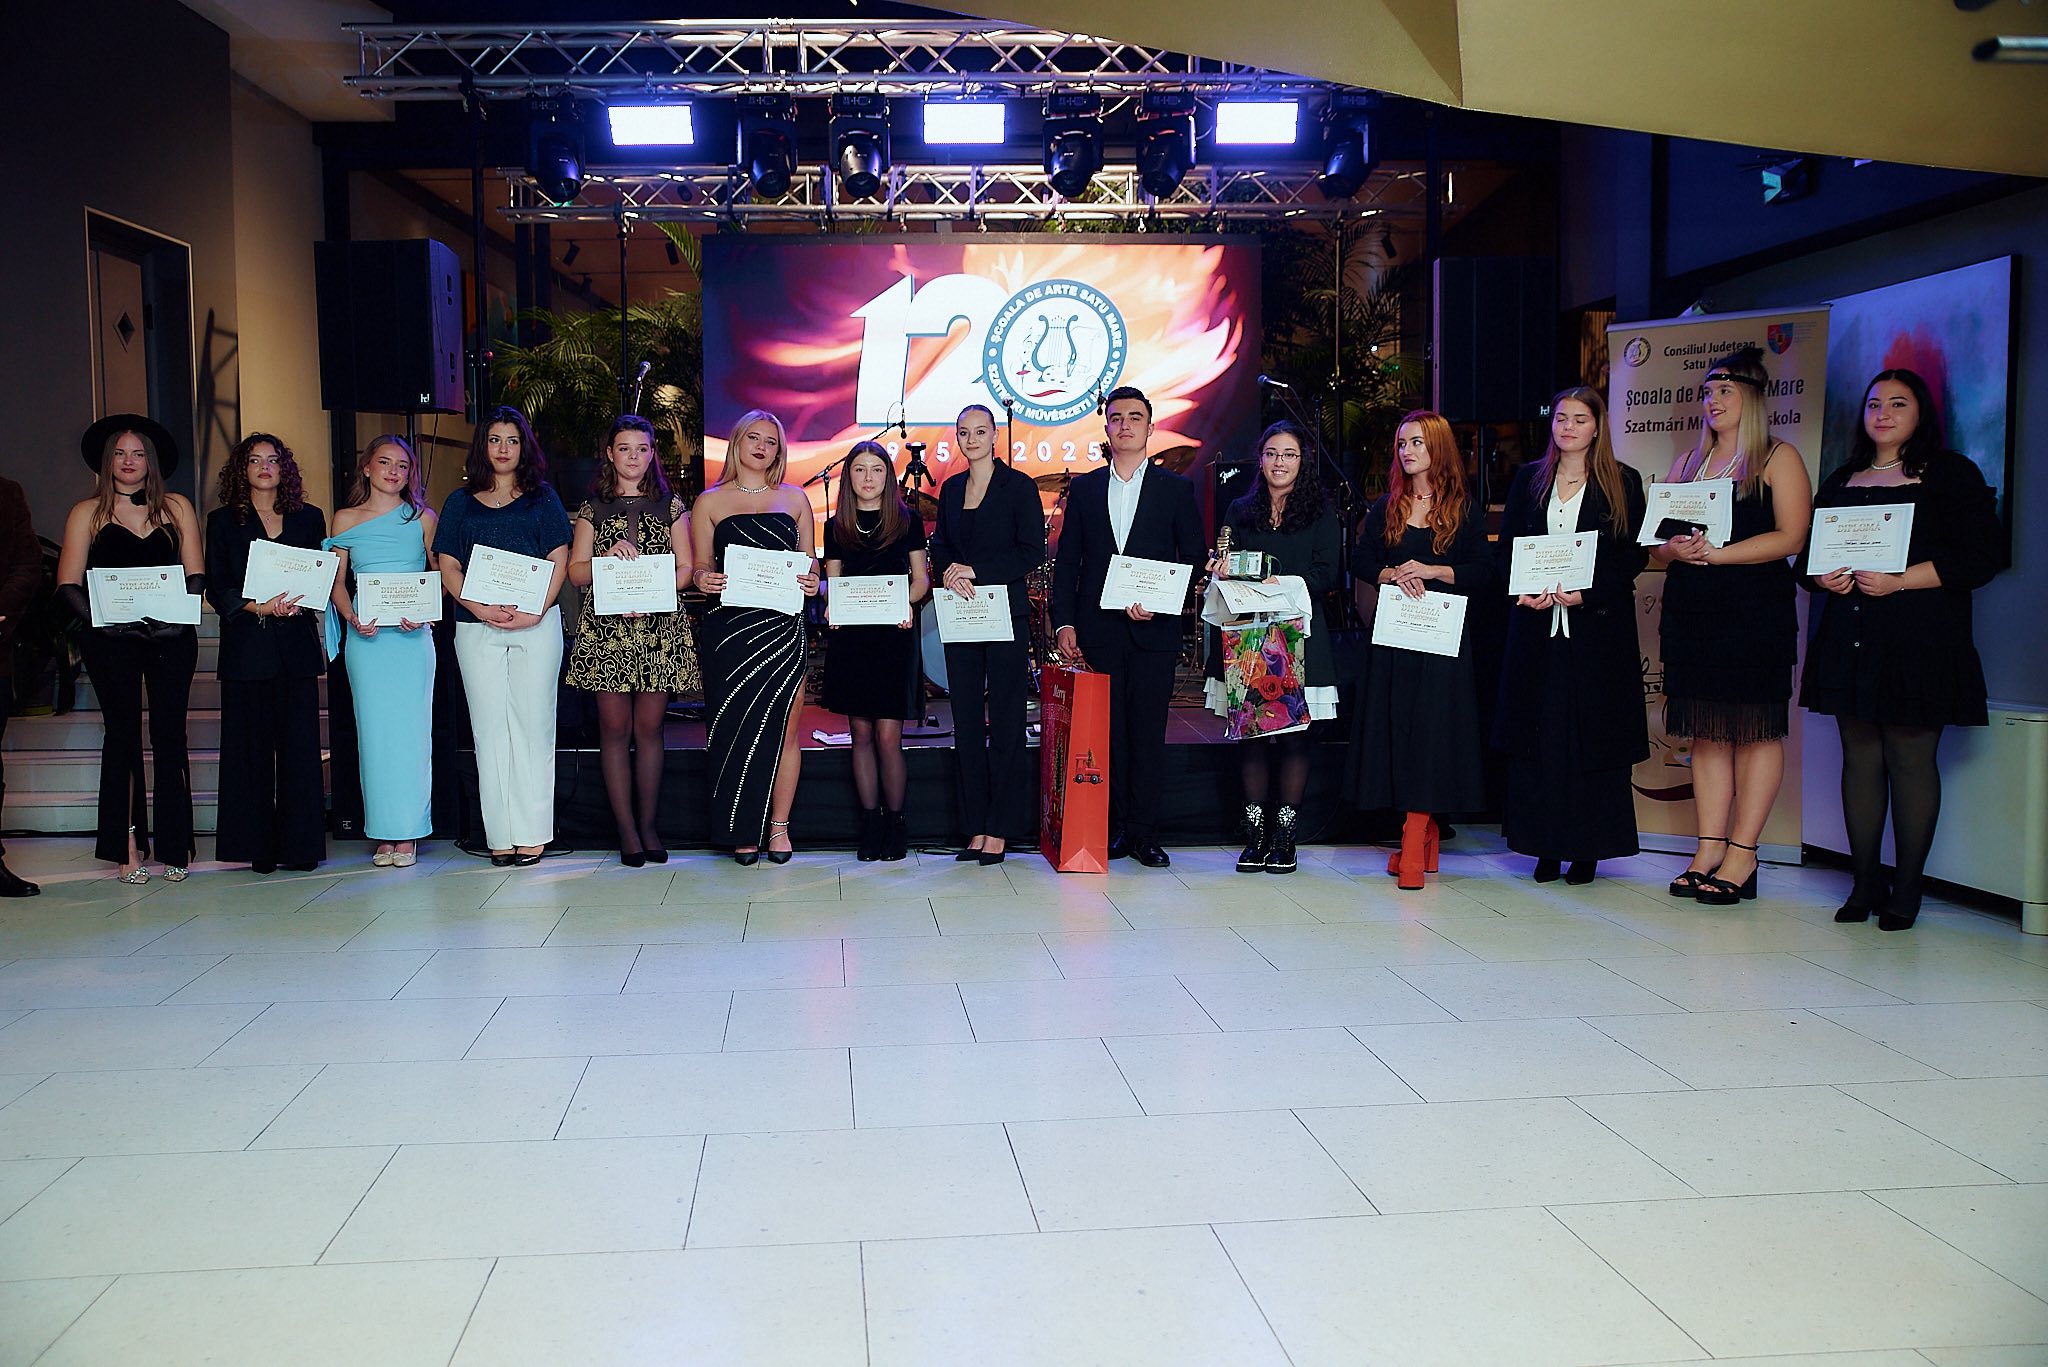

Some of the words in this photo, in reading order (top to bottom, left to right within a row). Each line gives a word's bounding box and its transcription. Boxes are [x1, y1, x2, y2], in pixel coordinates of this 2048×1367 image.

[1025, 287, 1043, 302] DE
[1045, 284, 1079, 297] ARTE
[1080, 289, 1110, 314] SATU
[1105, 314, 1123, 349] MARE
[1664, 343, 1706, 357] Consiliul
[1683, 360, 1706, 371] Satu
[988, 363, 1026, 414] SZATMRI
[1626, 387, 1672, 412] Școala
[1676, 386, 1693, 403] de
[1768, 379, 1804, 397] Mare
[1625, 416, 1684, 434] Szatmári
[1768, 409, 1801, 426] skola
[1012, 441, 1102, 462] 2025
